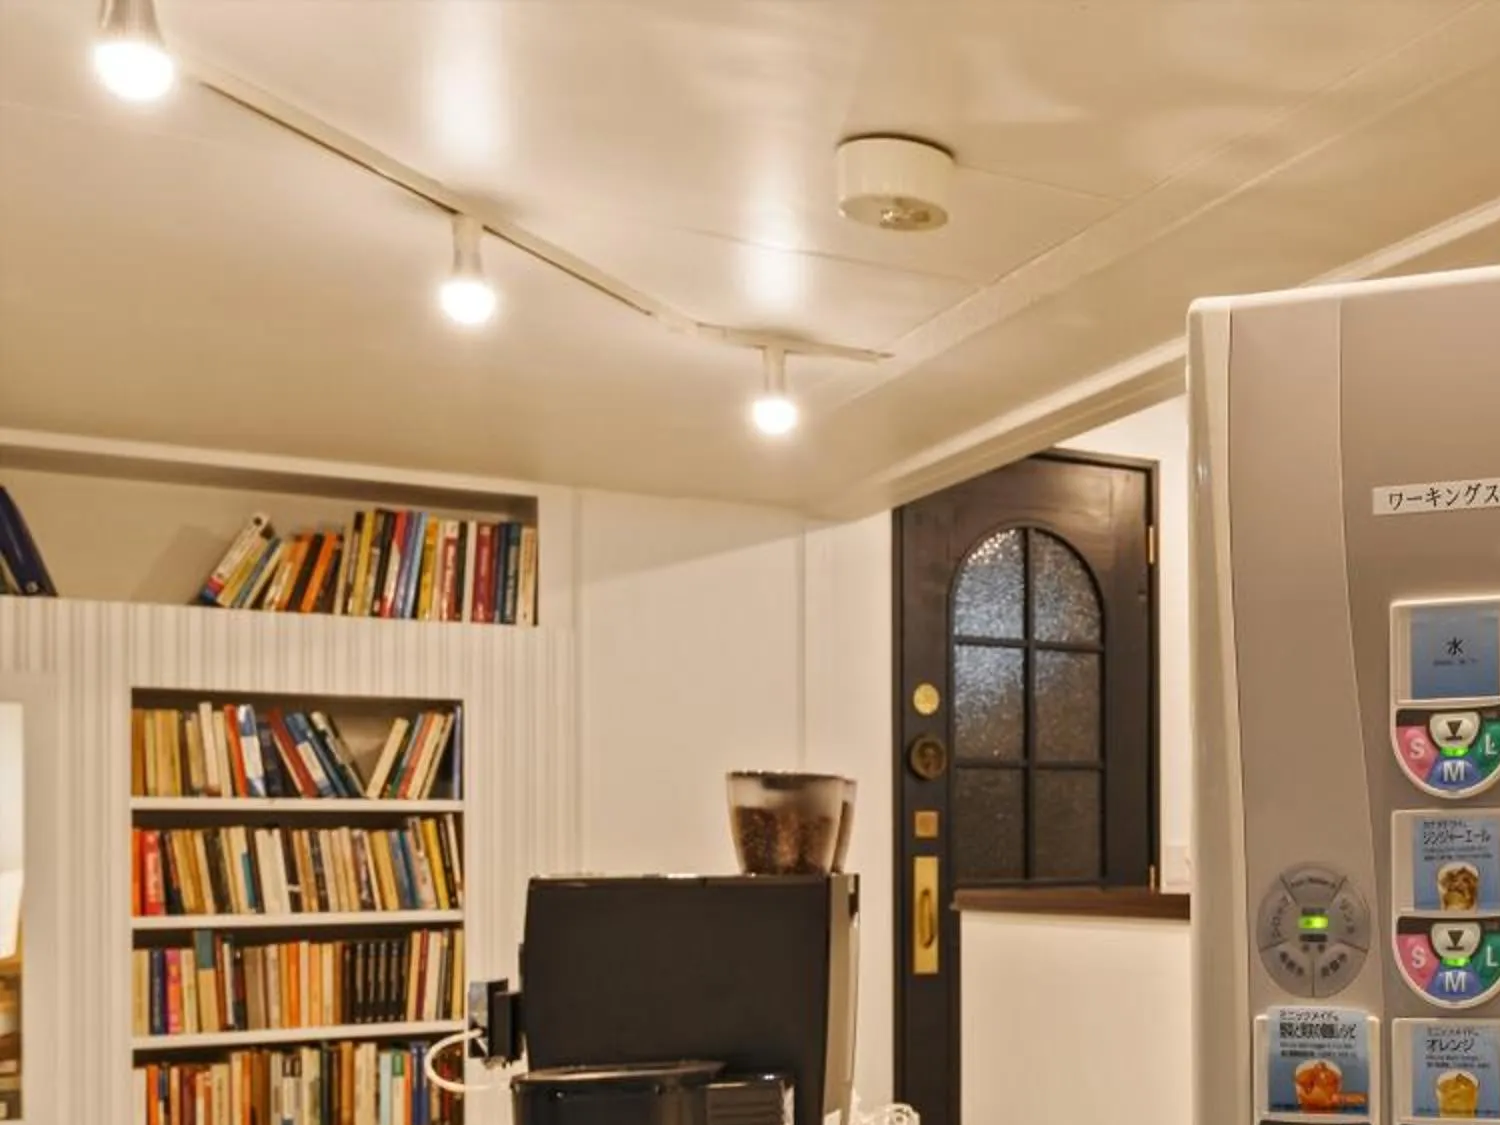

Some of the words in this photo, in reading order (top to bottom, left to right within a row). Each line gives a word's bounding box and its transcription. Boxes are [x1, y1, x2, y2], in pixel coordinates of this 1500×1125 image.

[1447, 637, 1464, 656] 水
[1409, 738, 1426, 758] S
[1485, 733, 1498, 755] L
[1443, 760, 1465, 782] M
[1411, 946, 1425, 968] S
[1485, 946, 1498, 967] L
[1444, 970, 1466, 993] M
[1425, 1037, 1475, 1052] オレンジ
